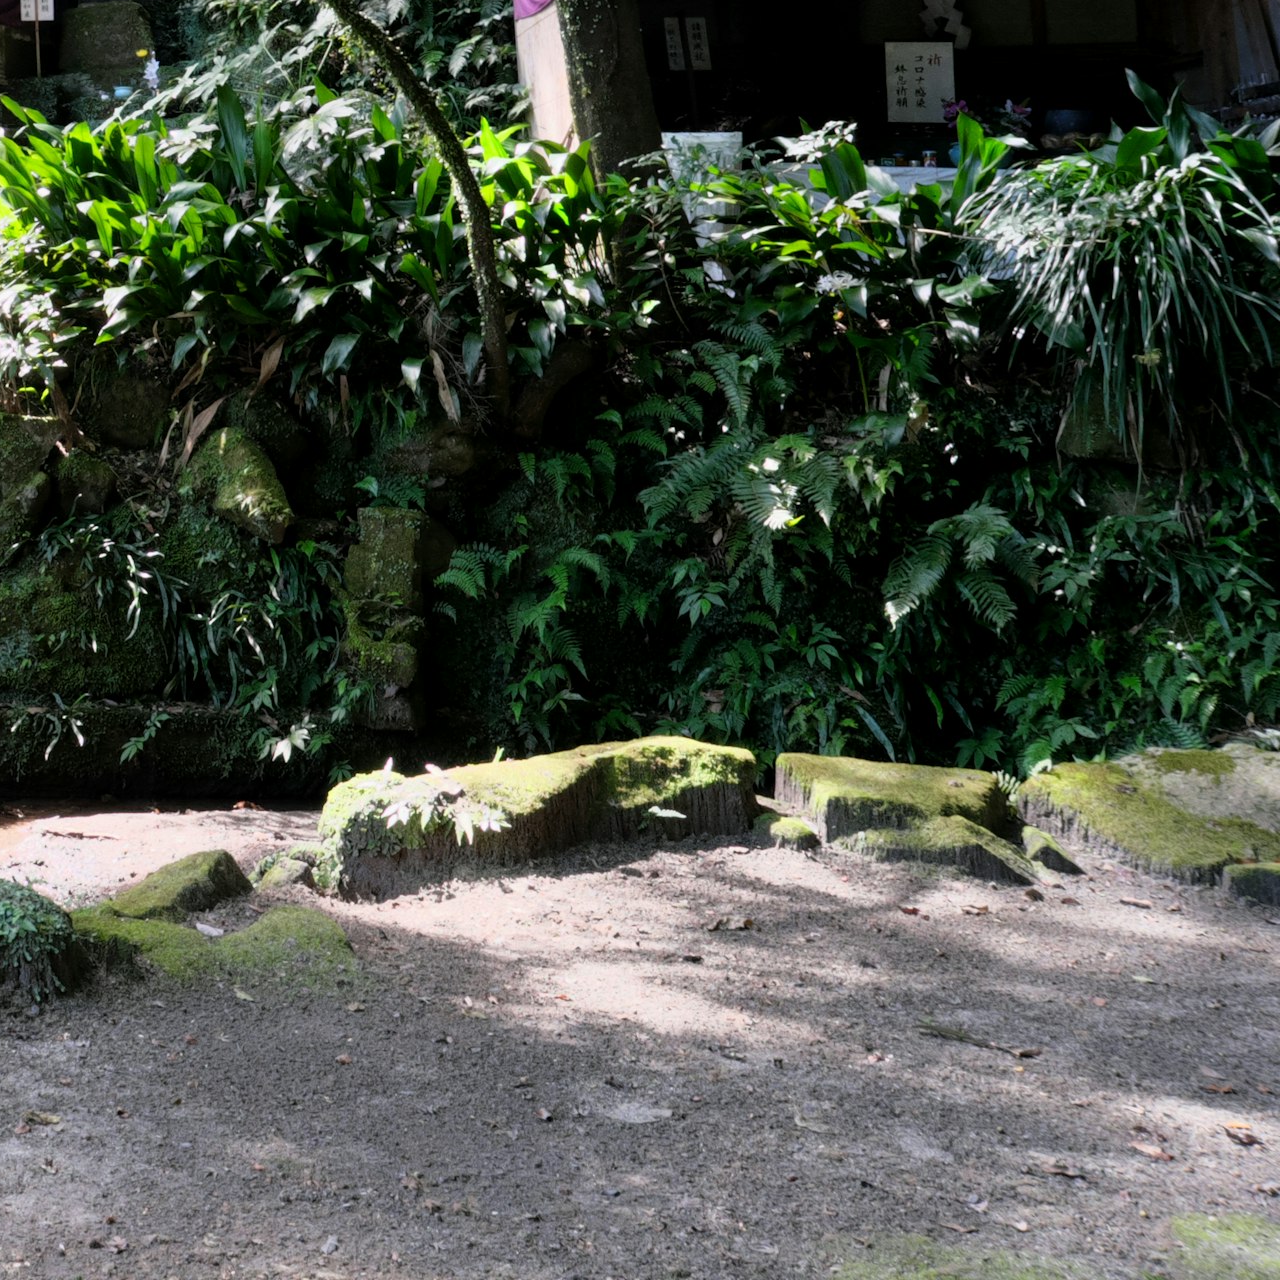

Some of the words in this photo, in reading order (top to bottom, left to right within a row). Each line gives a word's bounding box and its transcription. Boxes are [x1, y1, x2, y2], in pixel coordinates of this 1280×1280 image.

[915, 55, 927, 108] コロナ感染
[927, 53, 942, 66] 祈
[894, 64, 908, 108] 終息祈願
